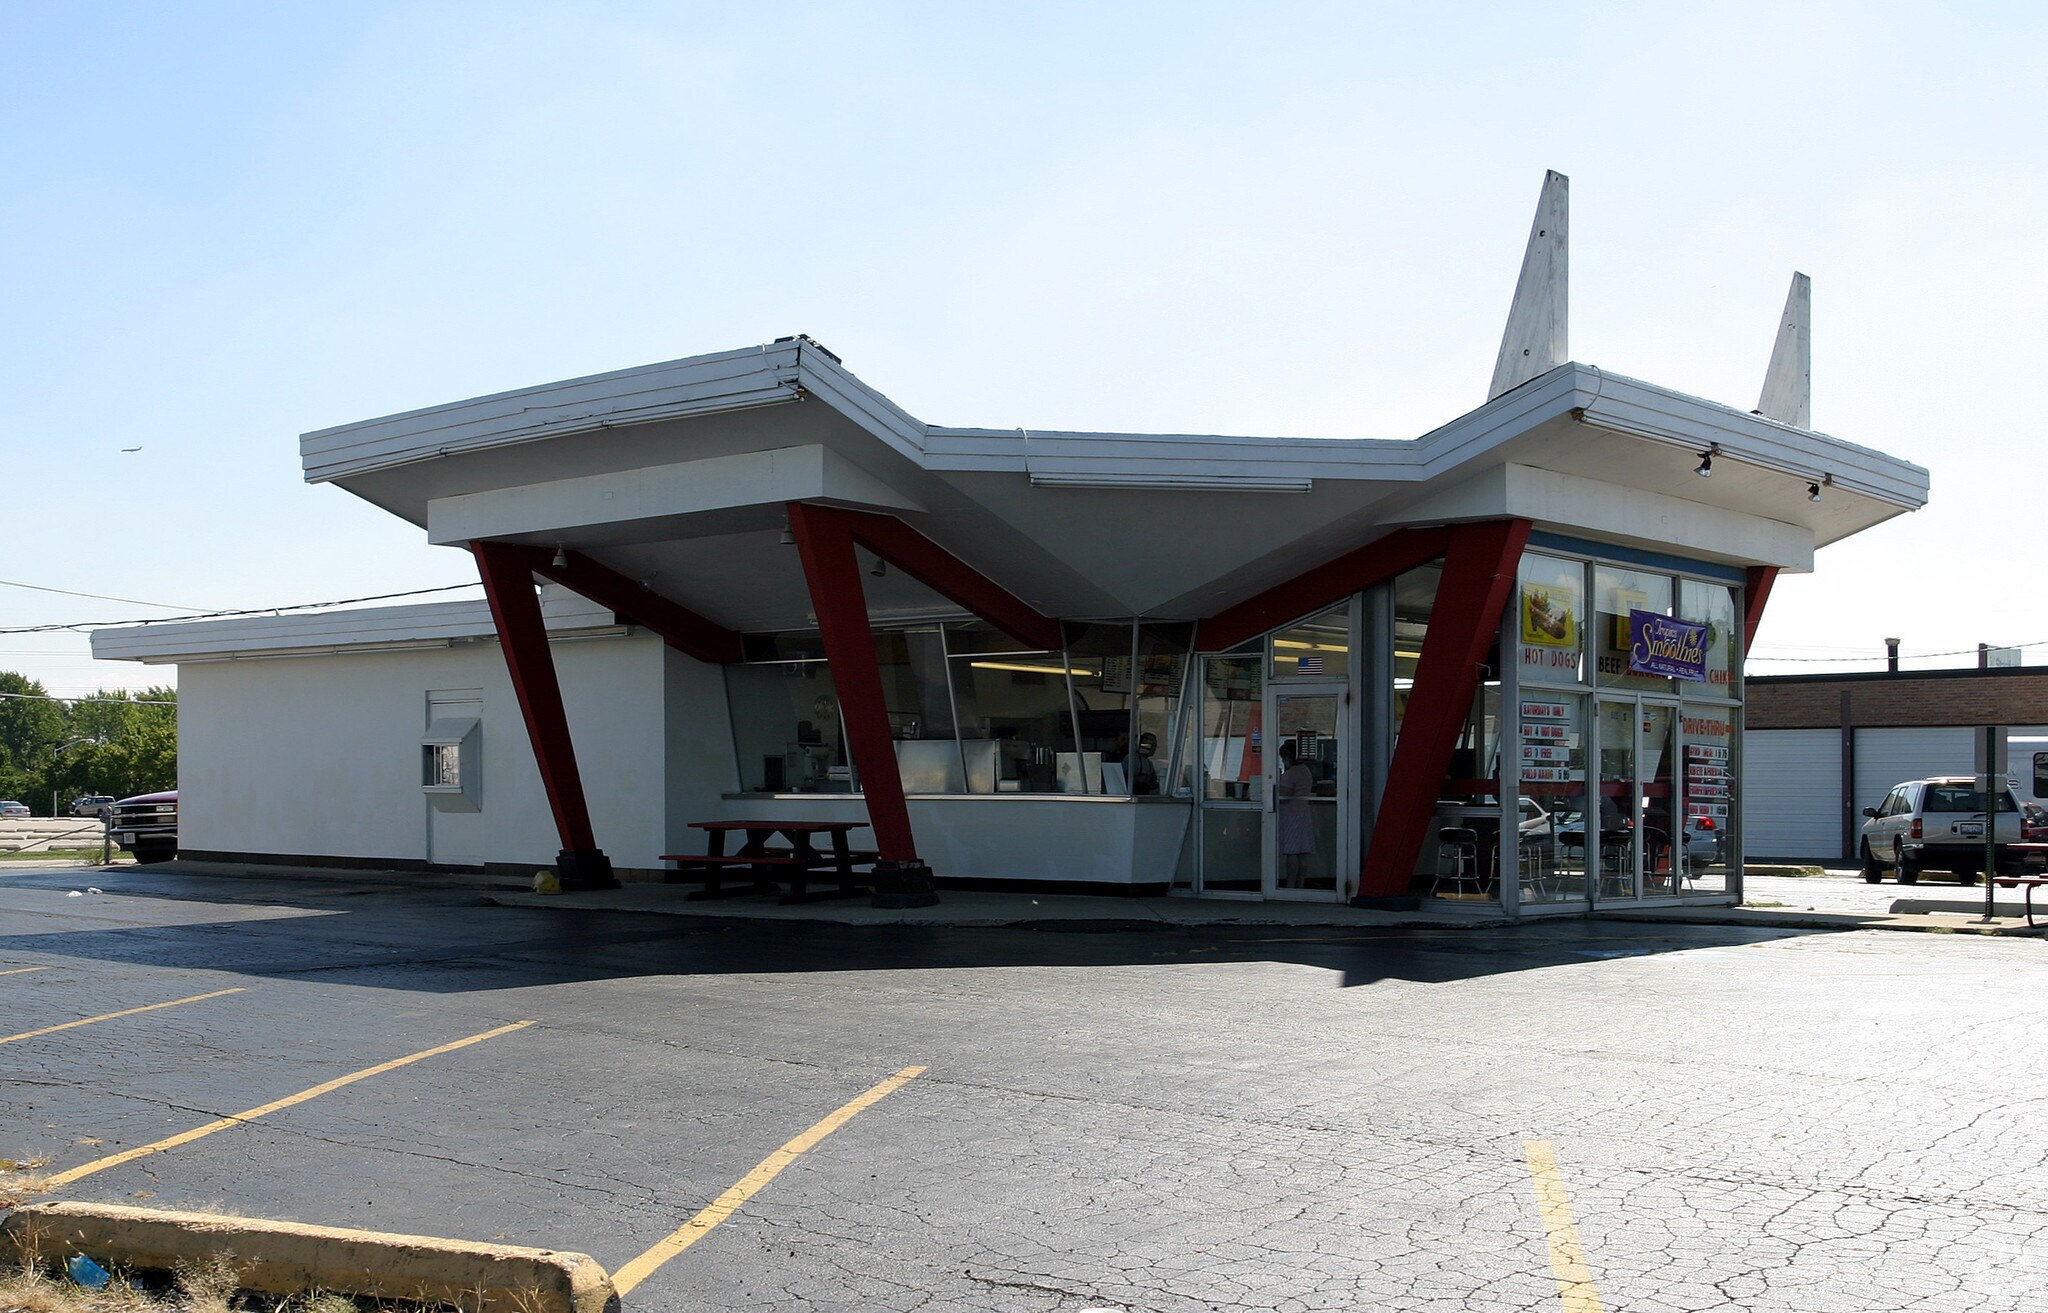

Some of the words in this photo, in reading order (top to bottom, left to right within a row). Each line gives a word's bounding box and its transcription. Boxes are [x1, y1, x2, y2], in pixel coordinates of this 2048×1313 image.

[1634, 624, 1703, 664] Smoothies
[1524, 648, 1544, 665] HOT
[1552, 650, 1577, 669] DOGS
[1599, 656, 1621, 675] BEEF
[1650, 661, 1658, 670] ALL
[1658, 663, 1677, 673] NATURAL
[1679, 666, 1688, 675] REAL
